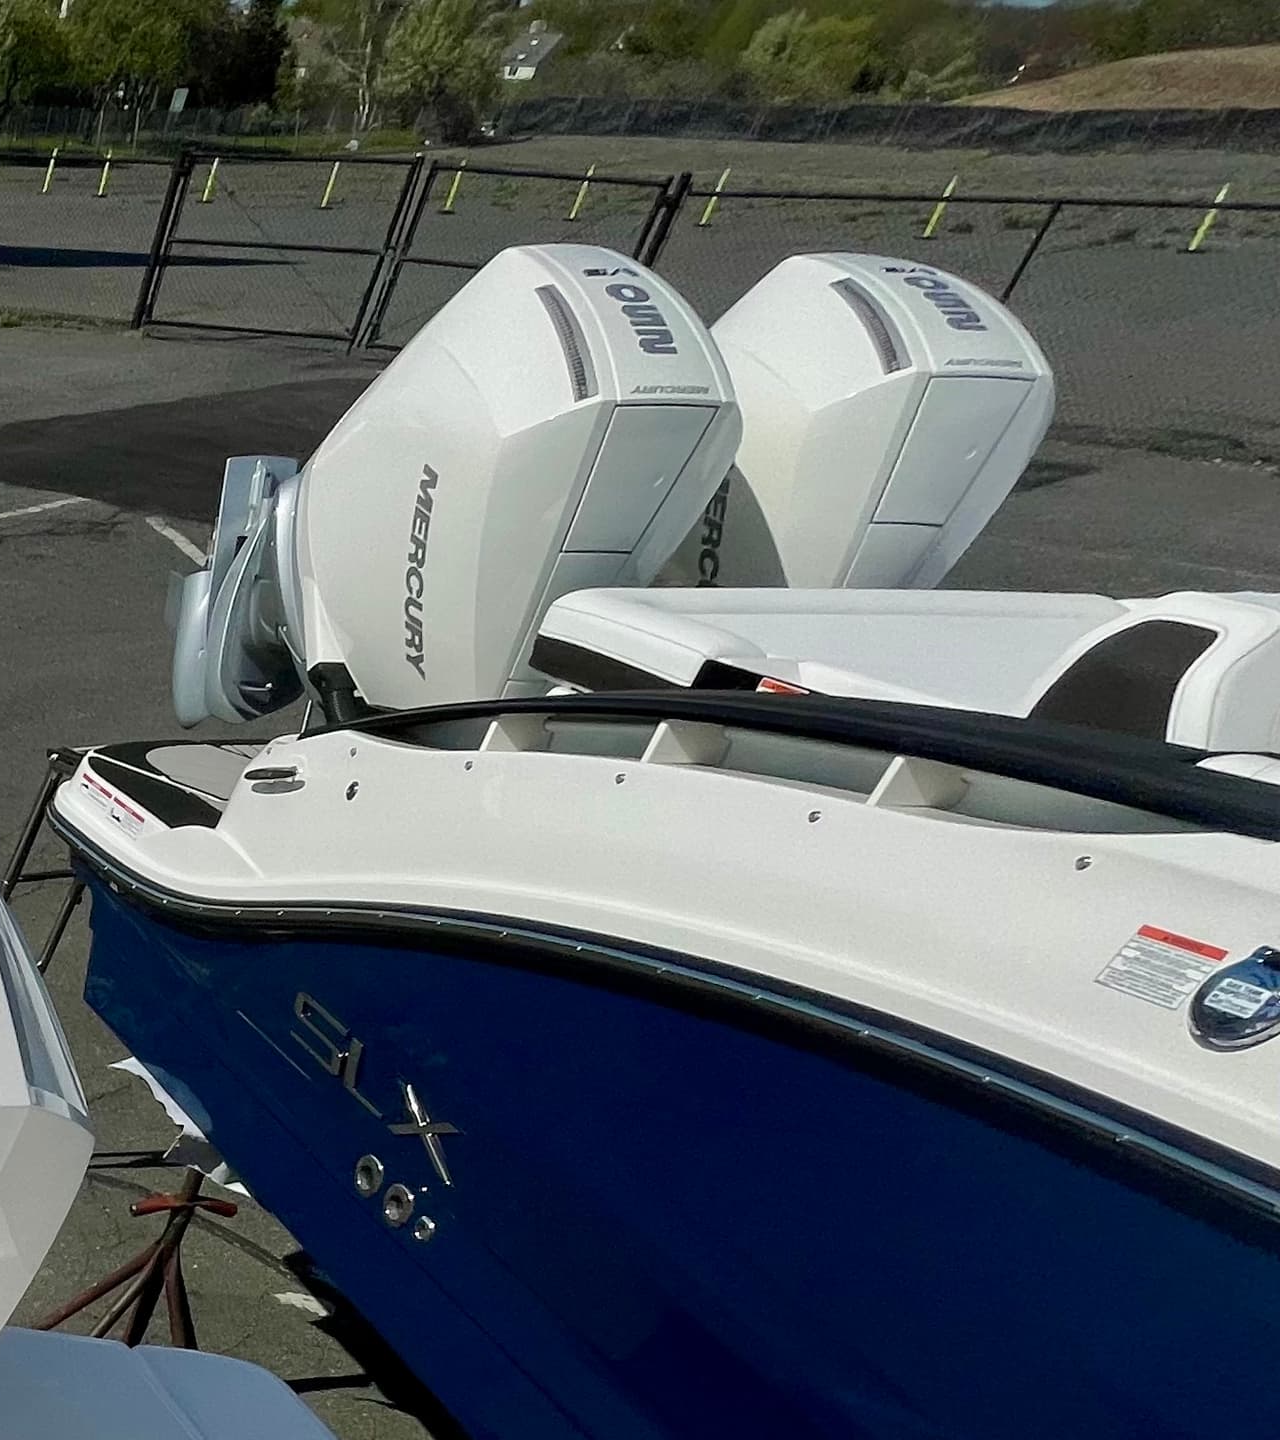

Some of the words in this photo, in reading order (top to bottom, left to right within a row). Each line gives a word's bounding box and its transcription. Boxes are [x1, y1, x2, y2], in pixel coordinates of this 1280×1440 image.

[605, 283, 678, 355] 250
[404, 463, 439, 681] MERCURY
[698, 478, 731, 587] ERC
